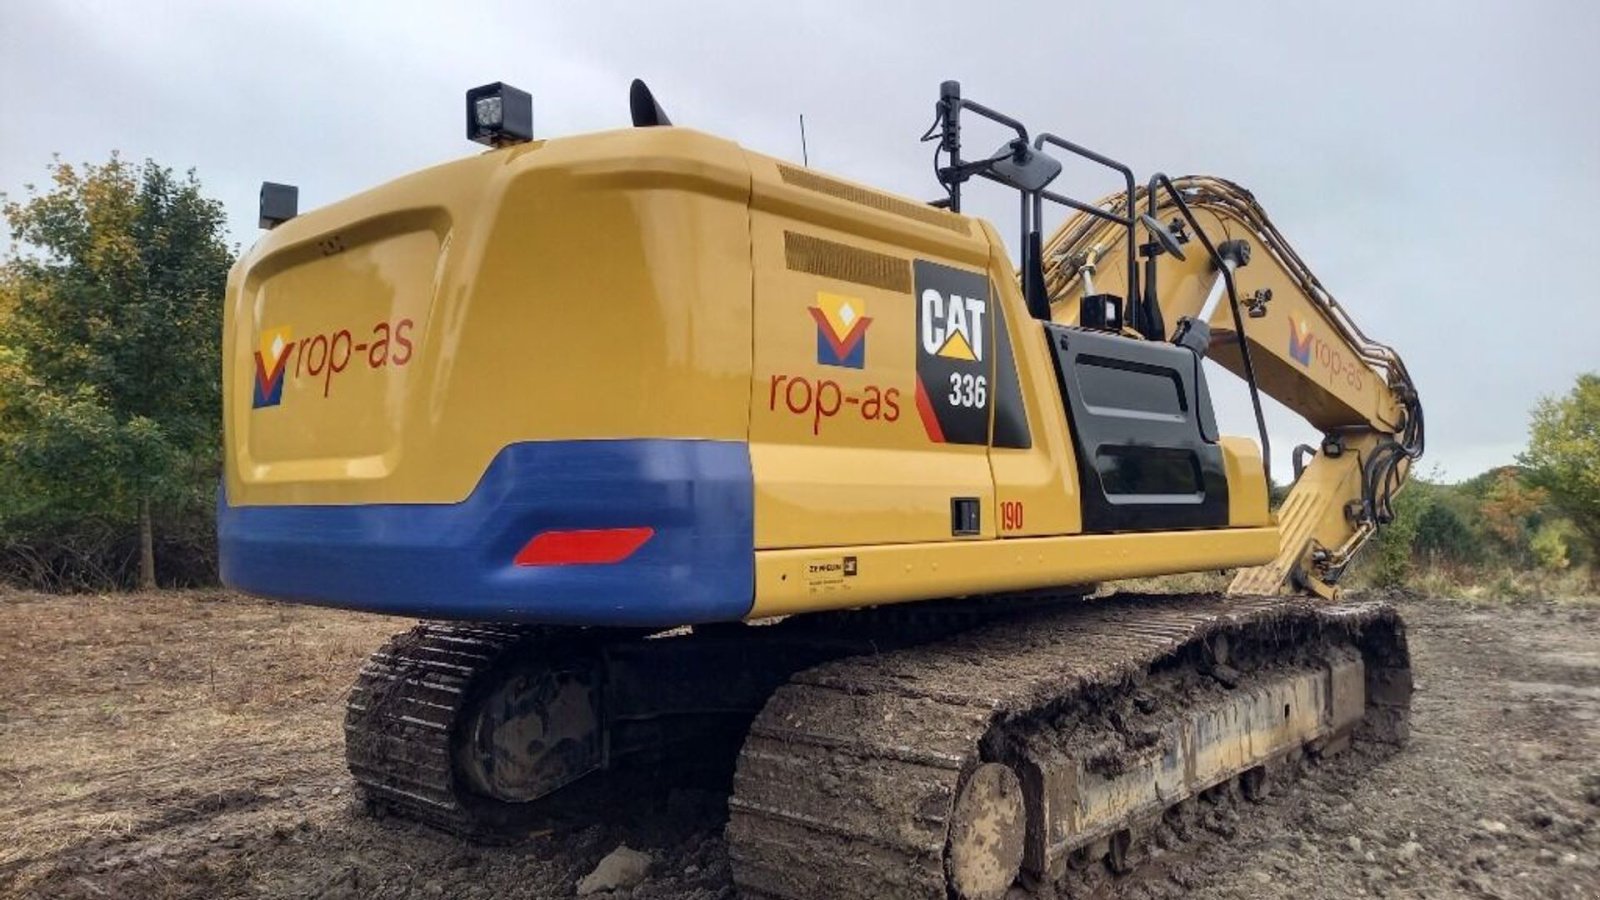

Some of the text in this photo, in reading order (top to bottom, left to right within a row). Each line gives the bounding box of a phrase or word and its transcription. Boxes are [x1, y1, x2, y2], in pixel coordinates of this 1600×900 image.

[921, 288, 986, 362] CAT
[295, 318, 413, 398] rop-as
[1315, 339, 1363, 391] rop-as
[770, 374, 900, 435] rop-as
[948, 371, 987, 409] 336
[1000, 501, 1023, 530] 190
